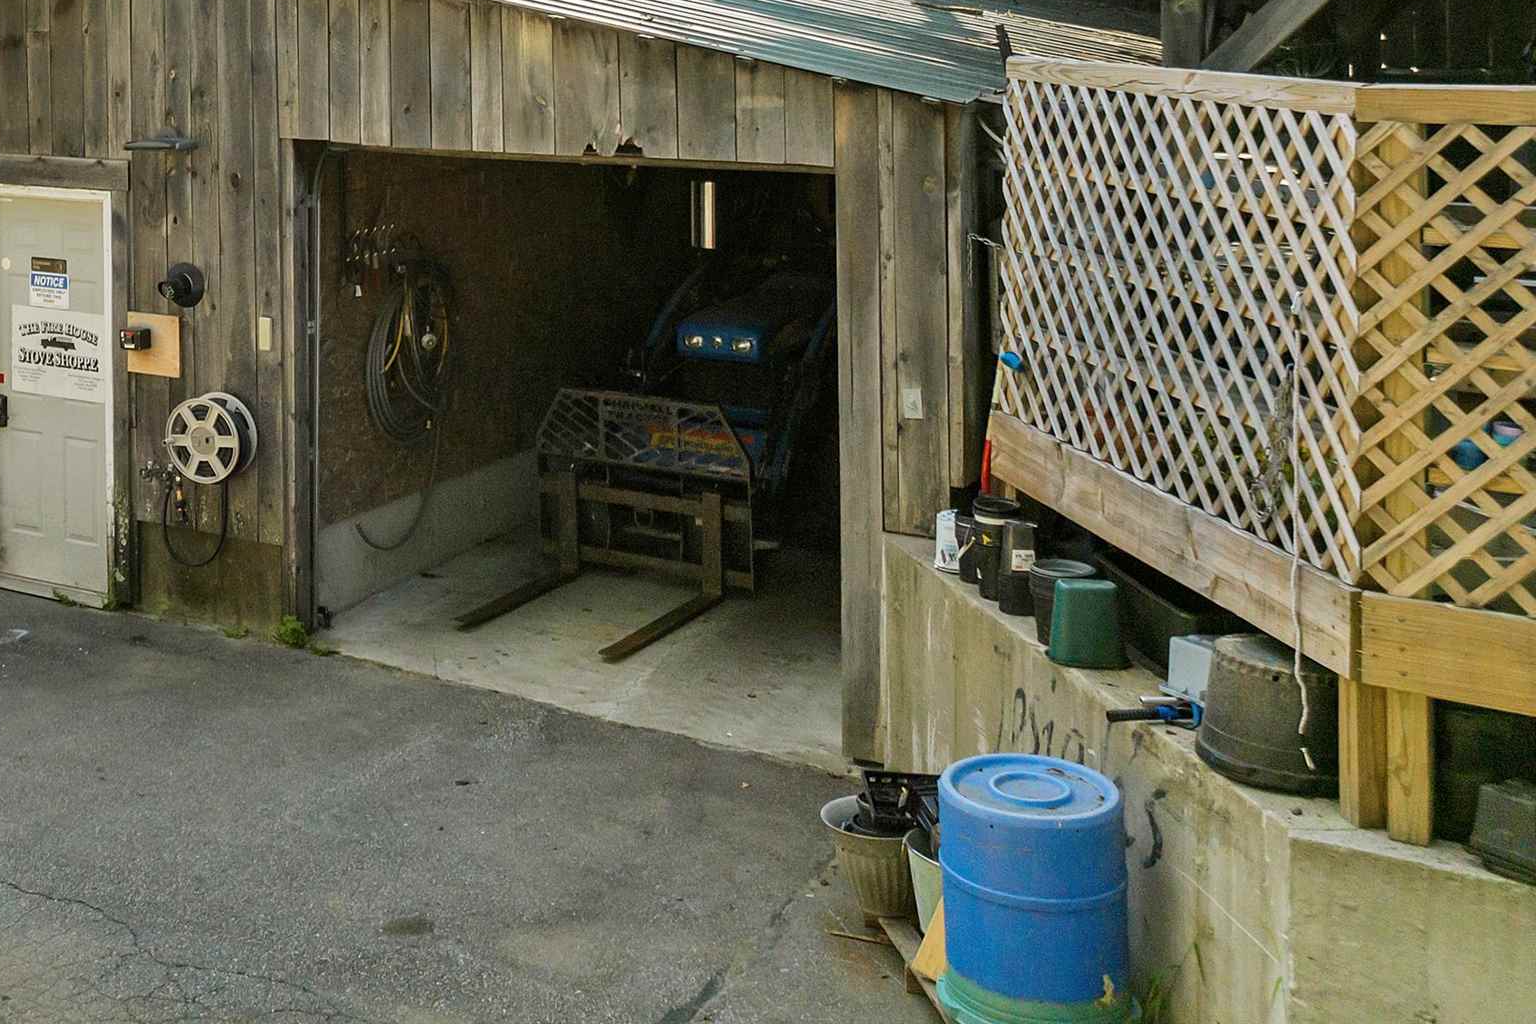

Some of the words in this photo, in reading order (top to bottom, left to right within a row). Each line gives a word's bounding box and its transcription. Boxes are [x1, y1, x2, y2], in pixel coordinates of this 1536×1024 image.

[34, 275, 65, 288] NOTICE
[17, 321, 40, 337] THE
[41, 321, 64, 335] FIRE
[64, 323, 98, 346] HOUSE
[18, 347, 54, 367] STOVE
[54, 351, 99, 373] SHOPPE
